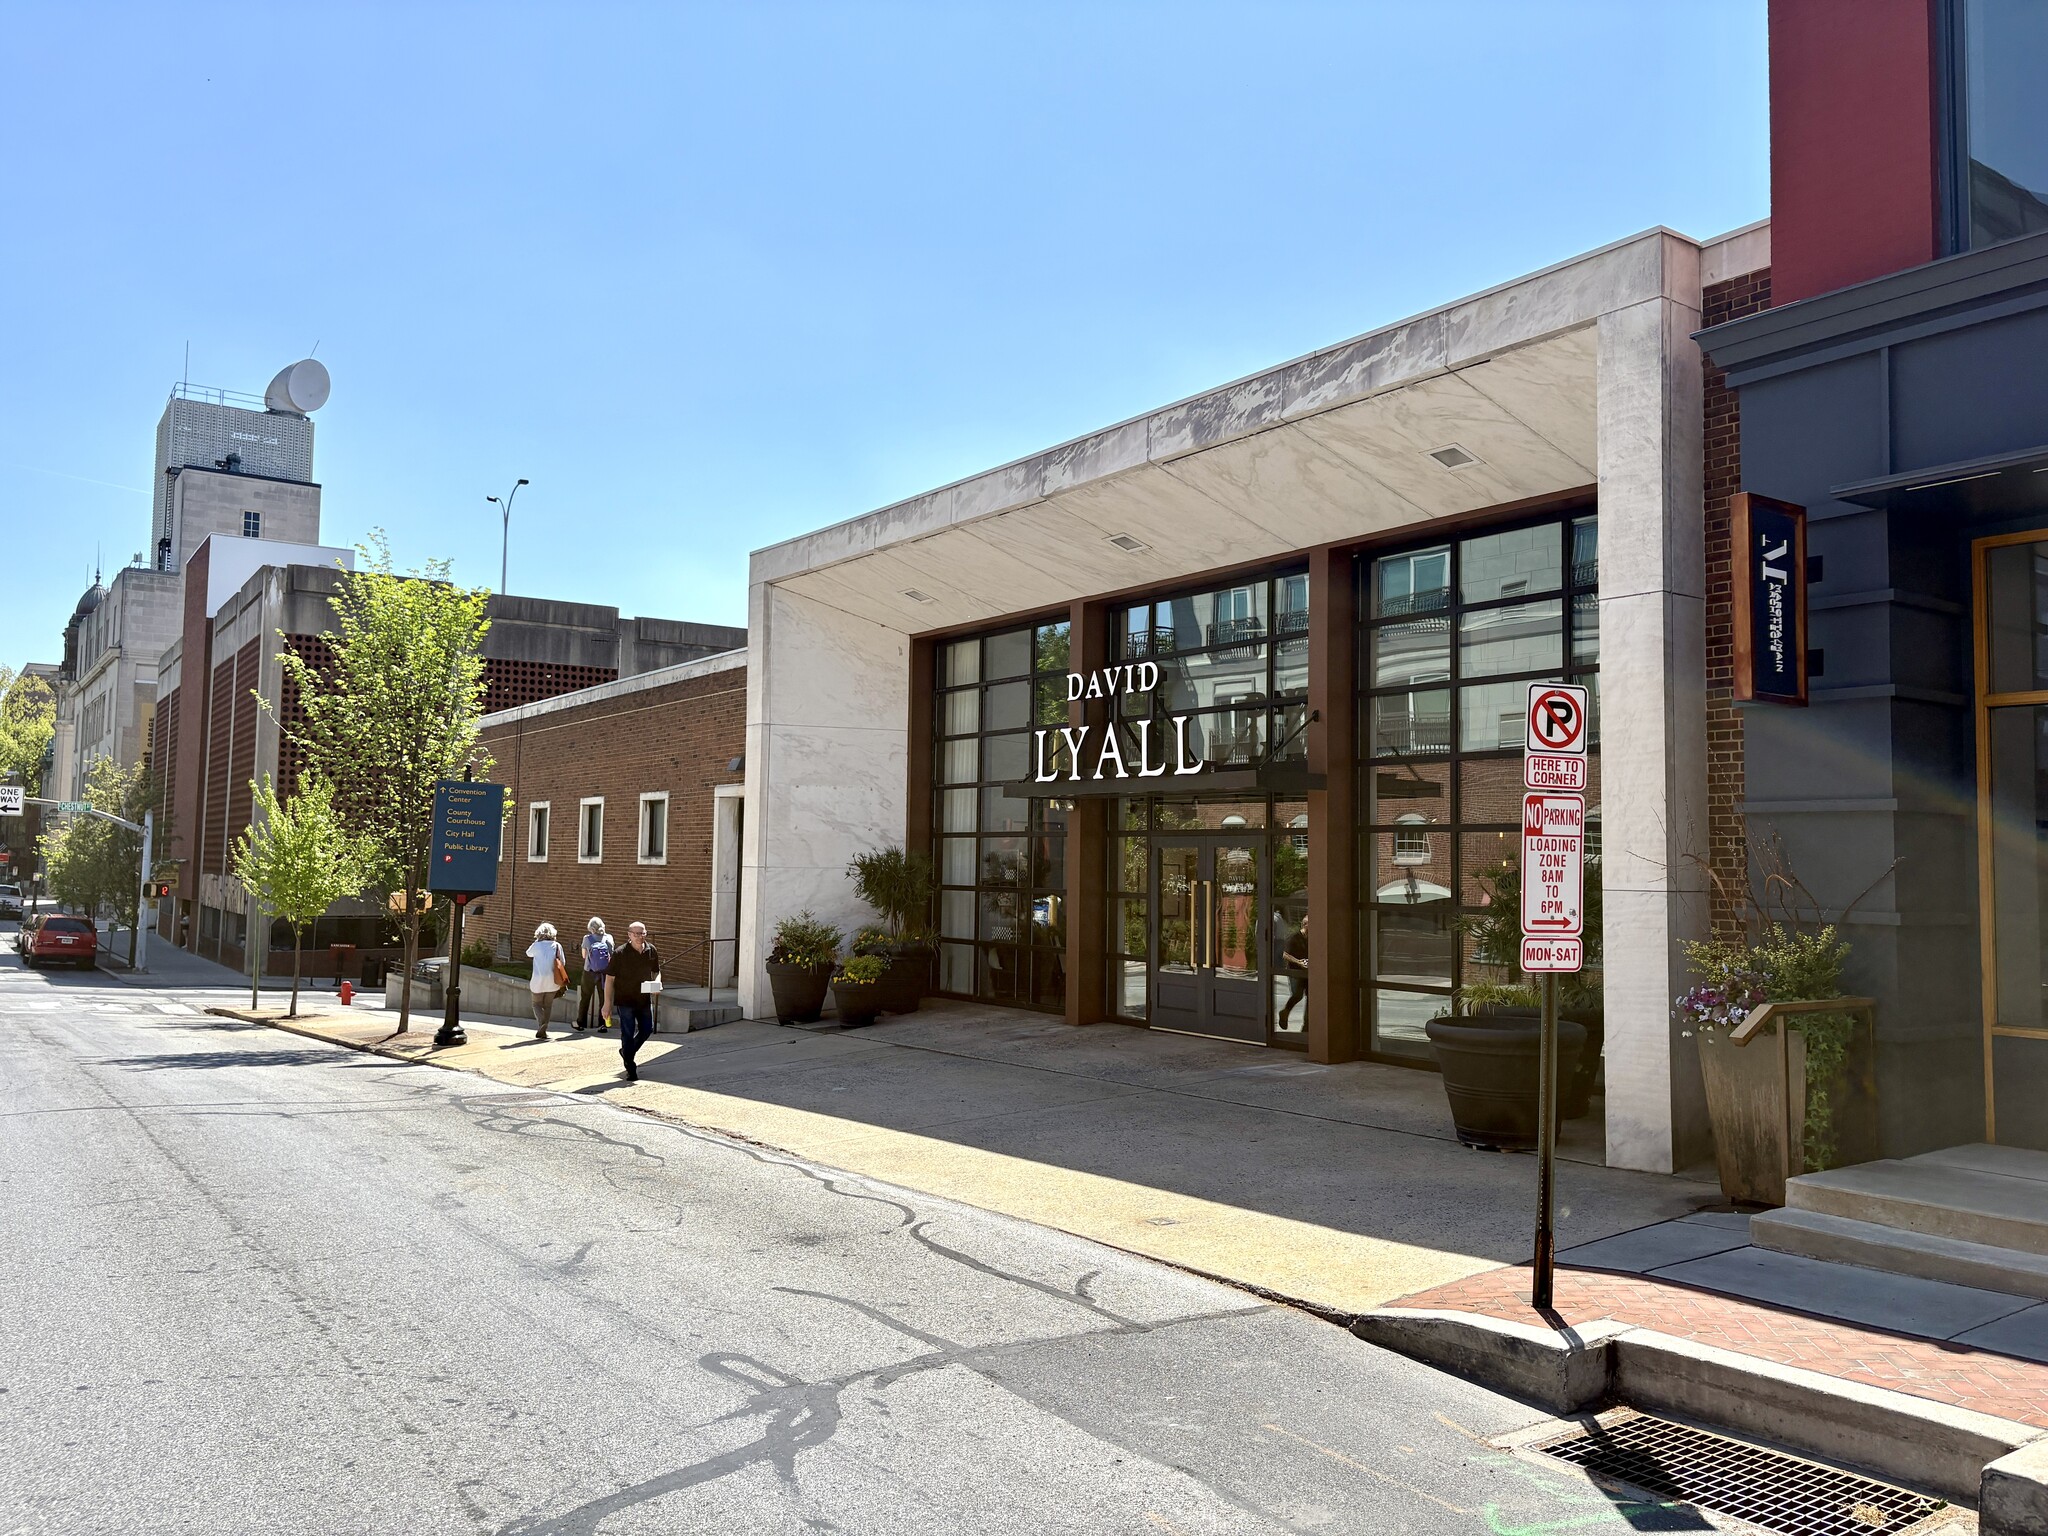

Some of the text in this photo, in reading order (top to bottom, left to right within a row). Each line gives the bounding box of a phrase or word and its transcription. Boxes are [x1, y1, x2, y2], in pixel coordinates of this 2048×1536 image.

[1066, 661, 1159, 701] DAVID
[146, 717, 154, 748] GARAGE
[1034, 716, 1204, 783] LYALL
[1533, 759, 1579, 773] HERE TO
[1533, 771, 1577, 785] CORNER
[0, 788, 19, 796] ONE
[448, 786, 487, 796] Convention
[448, 795, 472, 803] Center
[447, 808, 472, 817] County
[1526, 803, 1580, 829] NO PARKING
[446, 816, 486, 825] Courthouse
[445, 829, 475, 838] City Hall
[444, 842, 489, 853] Public Library
[1530, 838, 1577, 852] LOADING
[1539, 854, 1567, 867] ZONE
[1541, 870, 1564, 883] 8AM
[1546, 885, 1559, 898] TO
[1541, 900, 1563, 914] 6PM
[1526, 947, 1578, 961] MON-SAT
